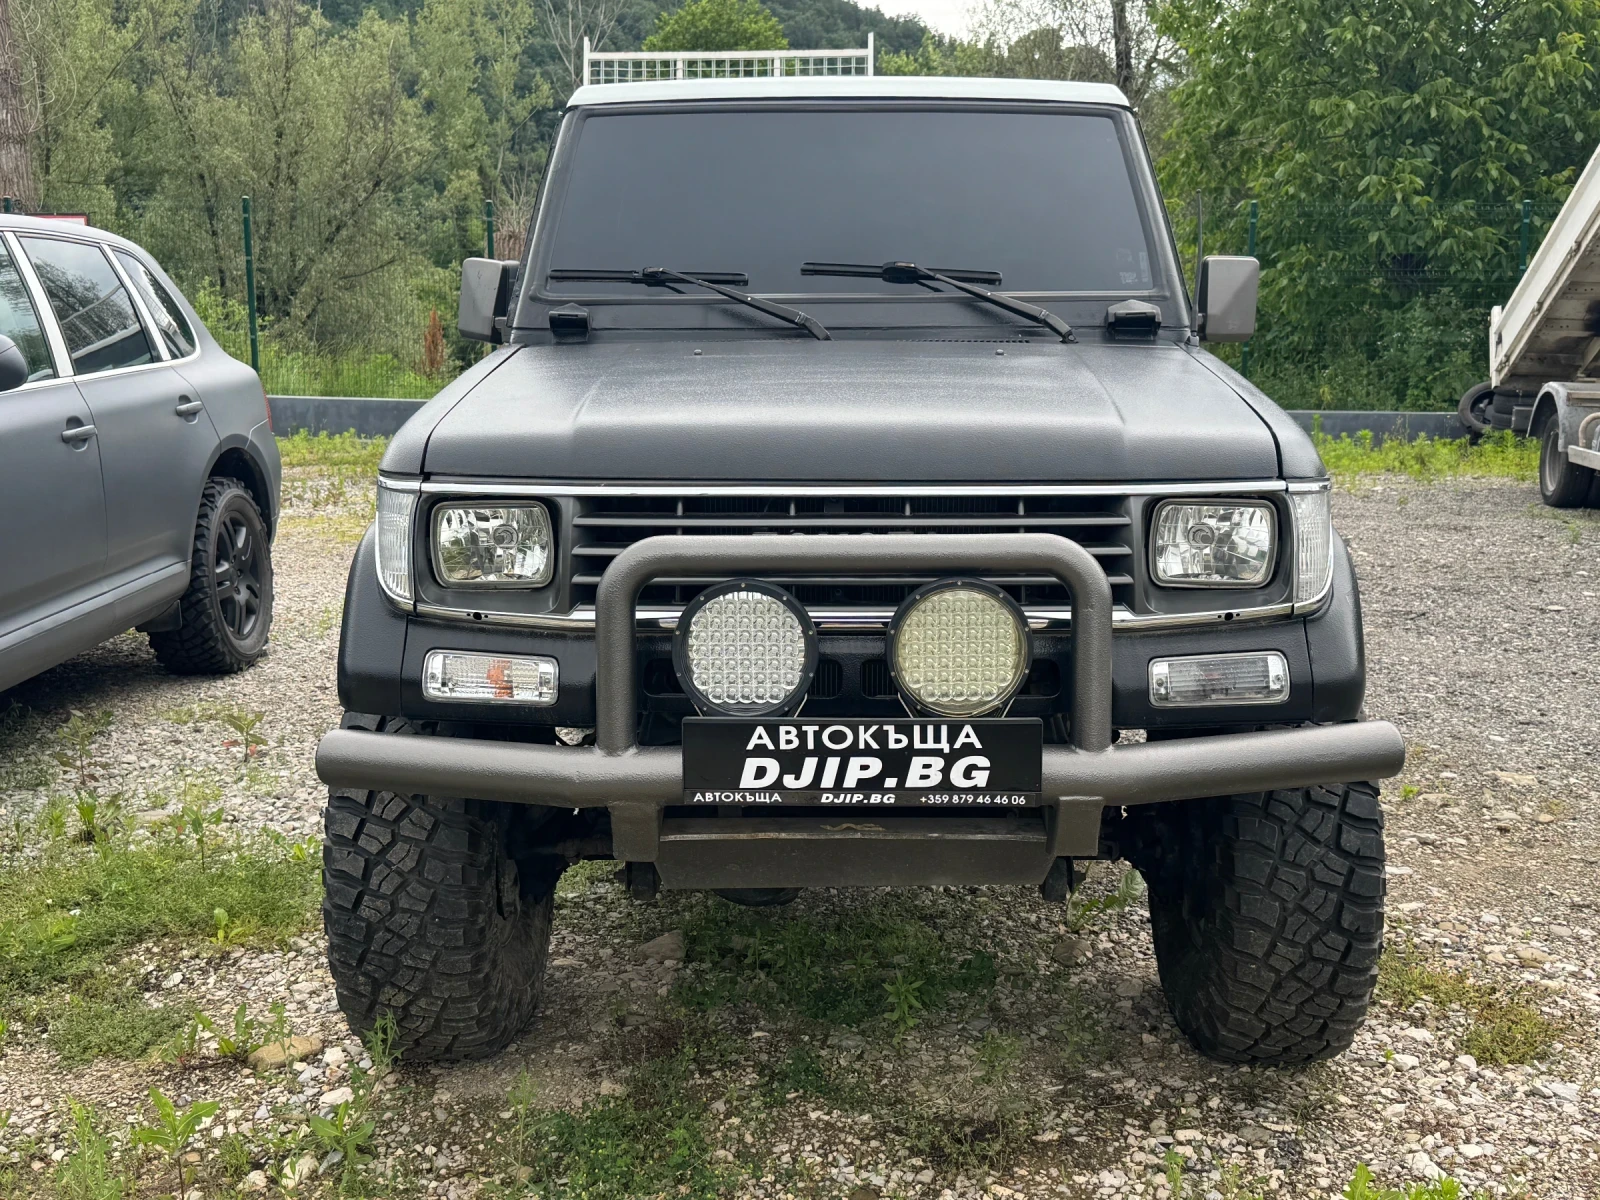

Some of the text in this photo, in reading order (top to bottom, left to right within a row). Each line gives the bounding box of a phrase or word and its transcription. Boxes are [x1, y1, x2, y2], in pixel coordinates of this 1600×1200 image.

[745, 724, 983, 754] АВТОКЪЩА
[738, 755, 991, 789] DJIP.BG
[693, 791, 783, 804] АВТОКЪЩА
[820, 793, 896, 804] DJIP.BG
[919, 794, 1027, 805] +359 879 46 46 06
